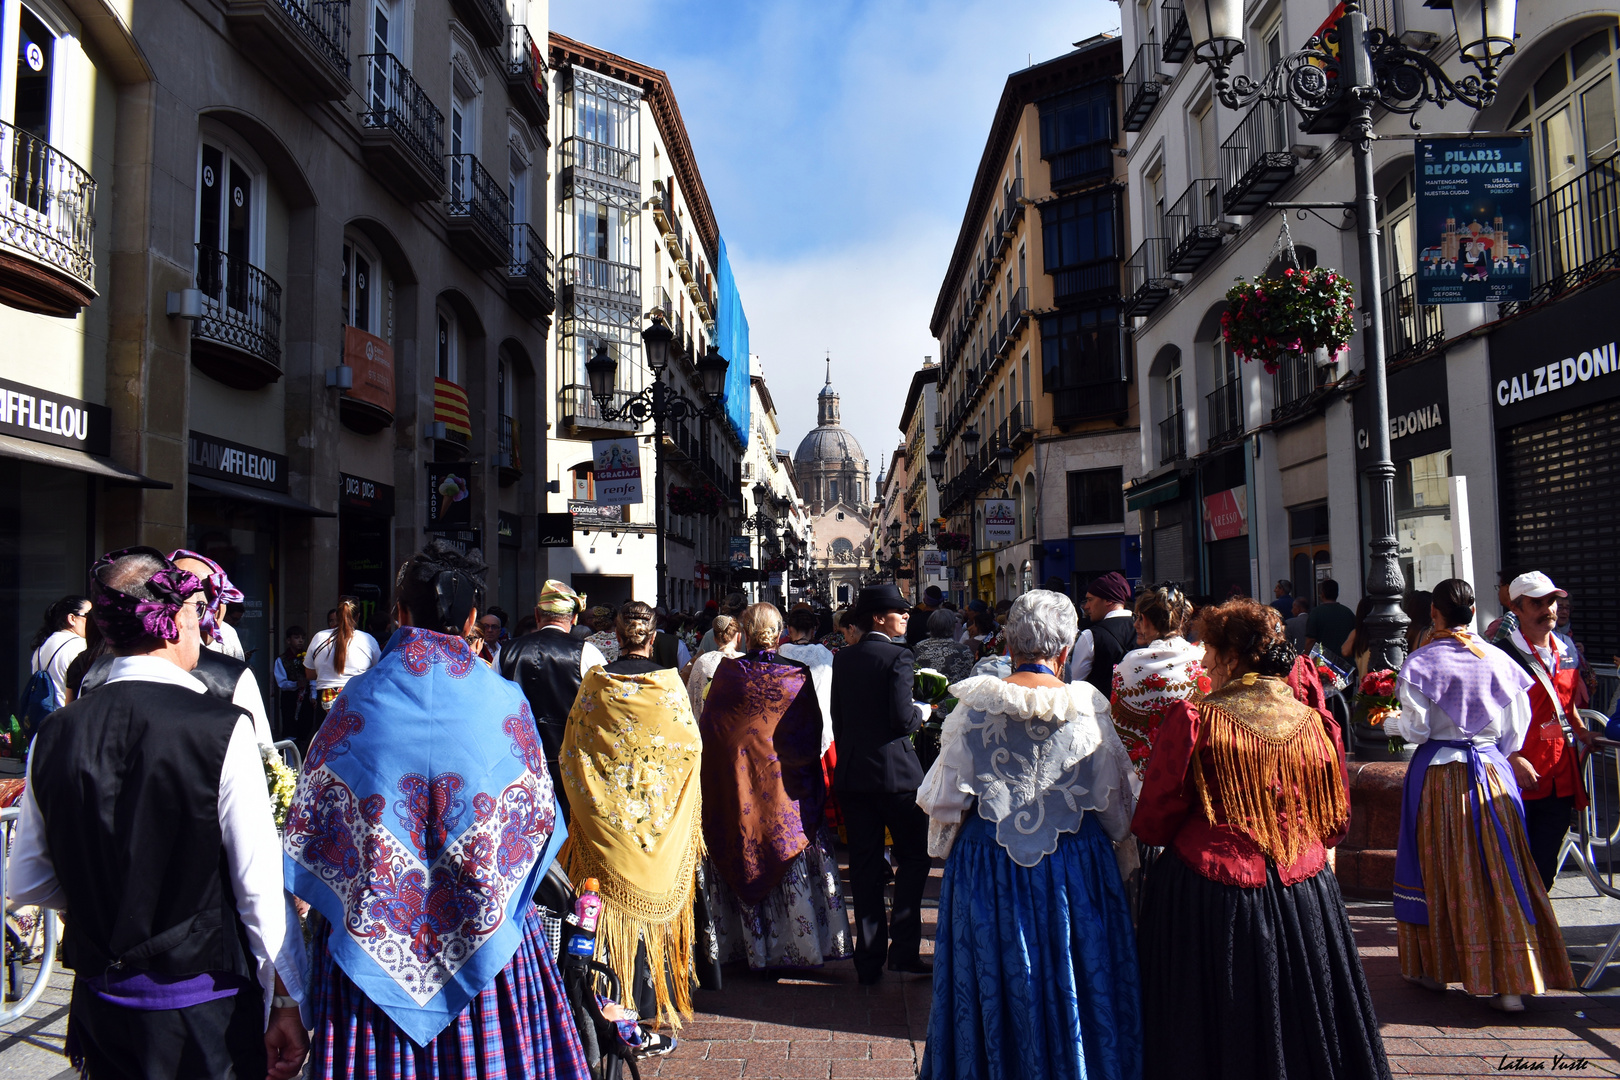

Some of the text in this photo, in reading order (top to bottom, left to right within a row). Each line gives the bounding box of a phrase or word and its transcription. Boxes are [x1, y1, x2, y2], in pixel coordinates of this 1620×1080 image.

[1444, 150, 1502, 162] PILAR23
[1424, 162, 1522, 175] RESPONSABLE
[1497, 341, 1620, 406] CALZEDONI
[1358, 403, 1442, 450] CEDONIA
[220, 448, 276, 482] AFFLELOU
[598, 470, 638, 479] ¡GRACIAS!
[604, 483, 635, 496] renfe
[542, 536, 568, 544] Clarks
